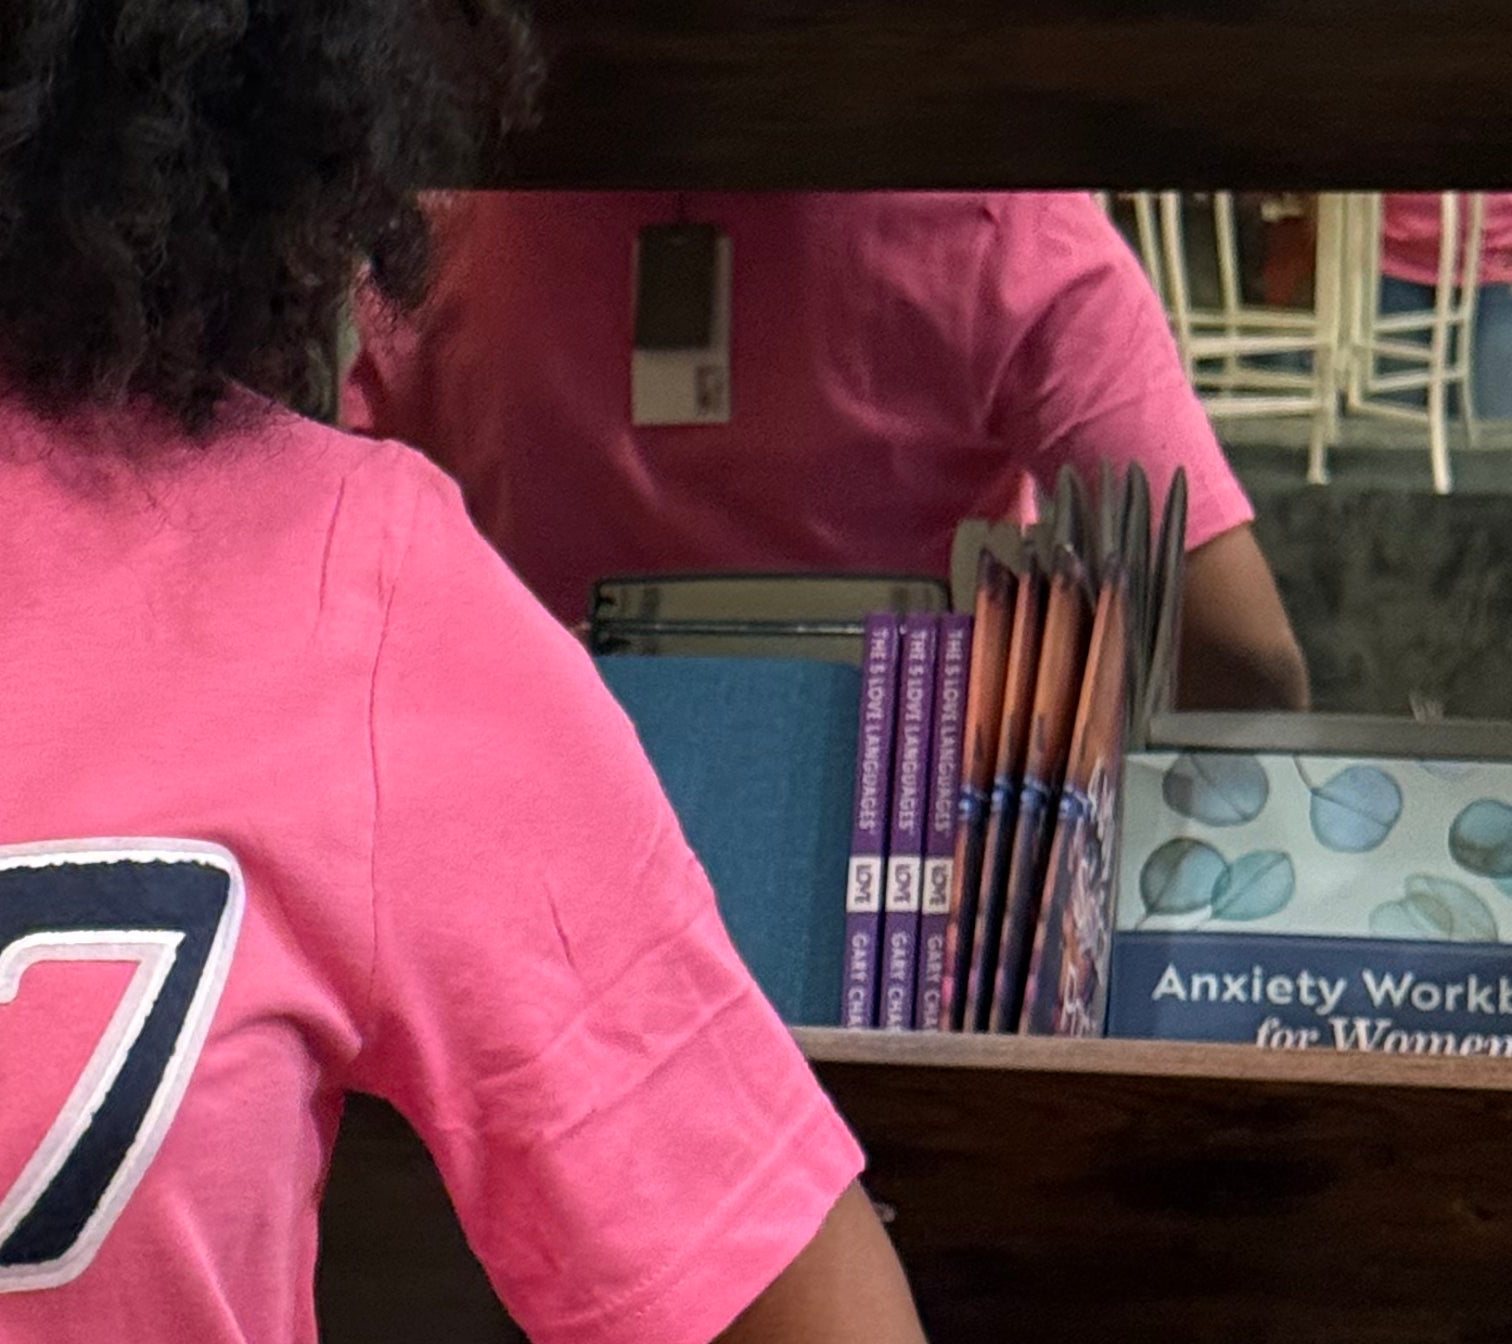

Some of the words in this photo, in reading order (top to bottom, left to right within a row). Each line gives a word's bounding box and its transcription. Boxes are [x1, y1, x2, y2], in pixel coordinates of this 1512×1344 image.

[870, 628, 889, 659] THE
[909, 630, 929, 661] THE
[945, 629, 964, 660] THE
[866, 677, 885, 720] LOVE
[905, 678, 923, 721] LOVE
[941, 679, 959, 722] LOVE
[854, 864, 873, 904] LOVE
[893, 863, 911, 904] LOVE
[929, 864, 948, 906] LOVE
[851, 932, 869, 982] GARY
[890, 931, 908, 982] GARY
[926, 935, 944, 983] GARY
[1151, 961, 1347, 1016] Anxiety
[1255, 1015, 1320, 1050] for
